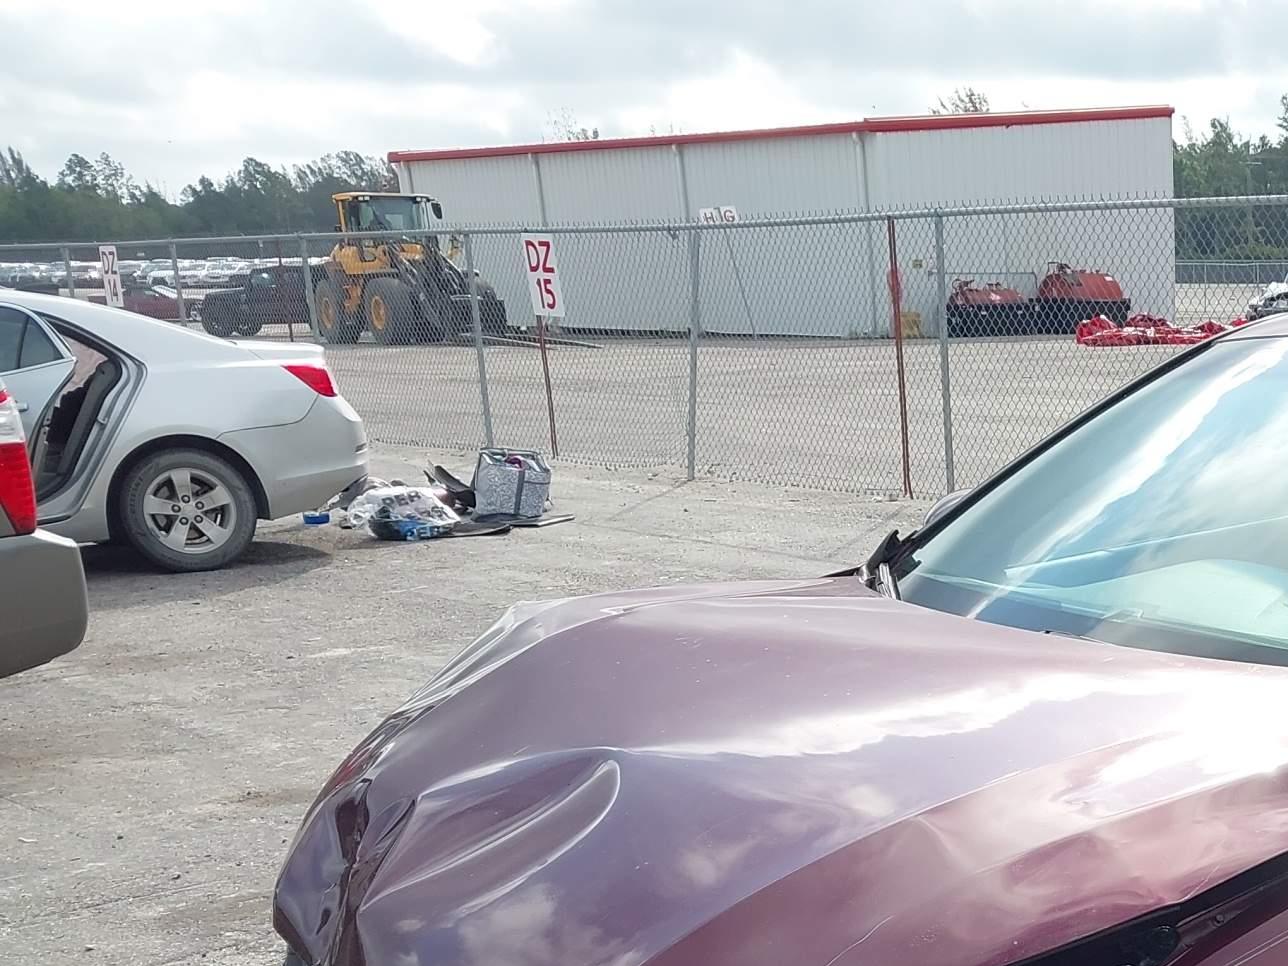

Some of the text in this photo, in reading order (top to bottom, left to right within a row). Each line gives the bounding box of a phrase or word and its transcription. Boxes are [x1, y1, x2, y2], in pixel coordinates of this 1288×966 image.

[101, 251, 118, 275] DZ
[524, 240, 555, 273] DZ
[535, 278, 557, 309] 15
